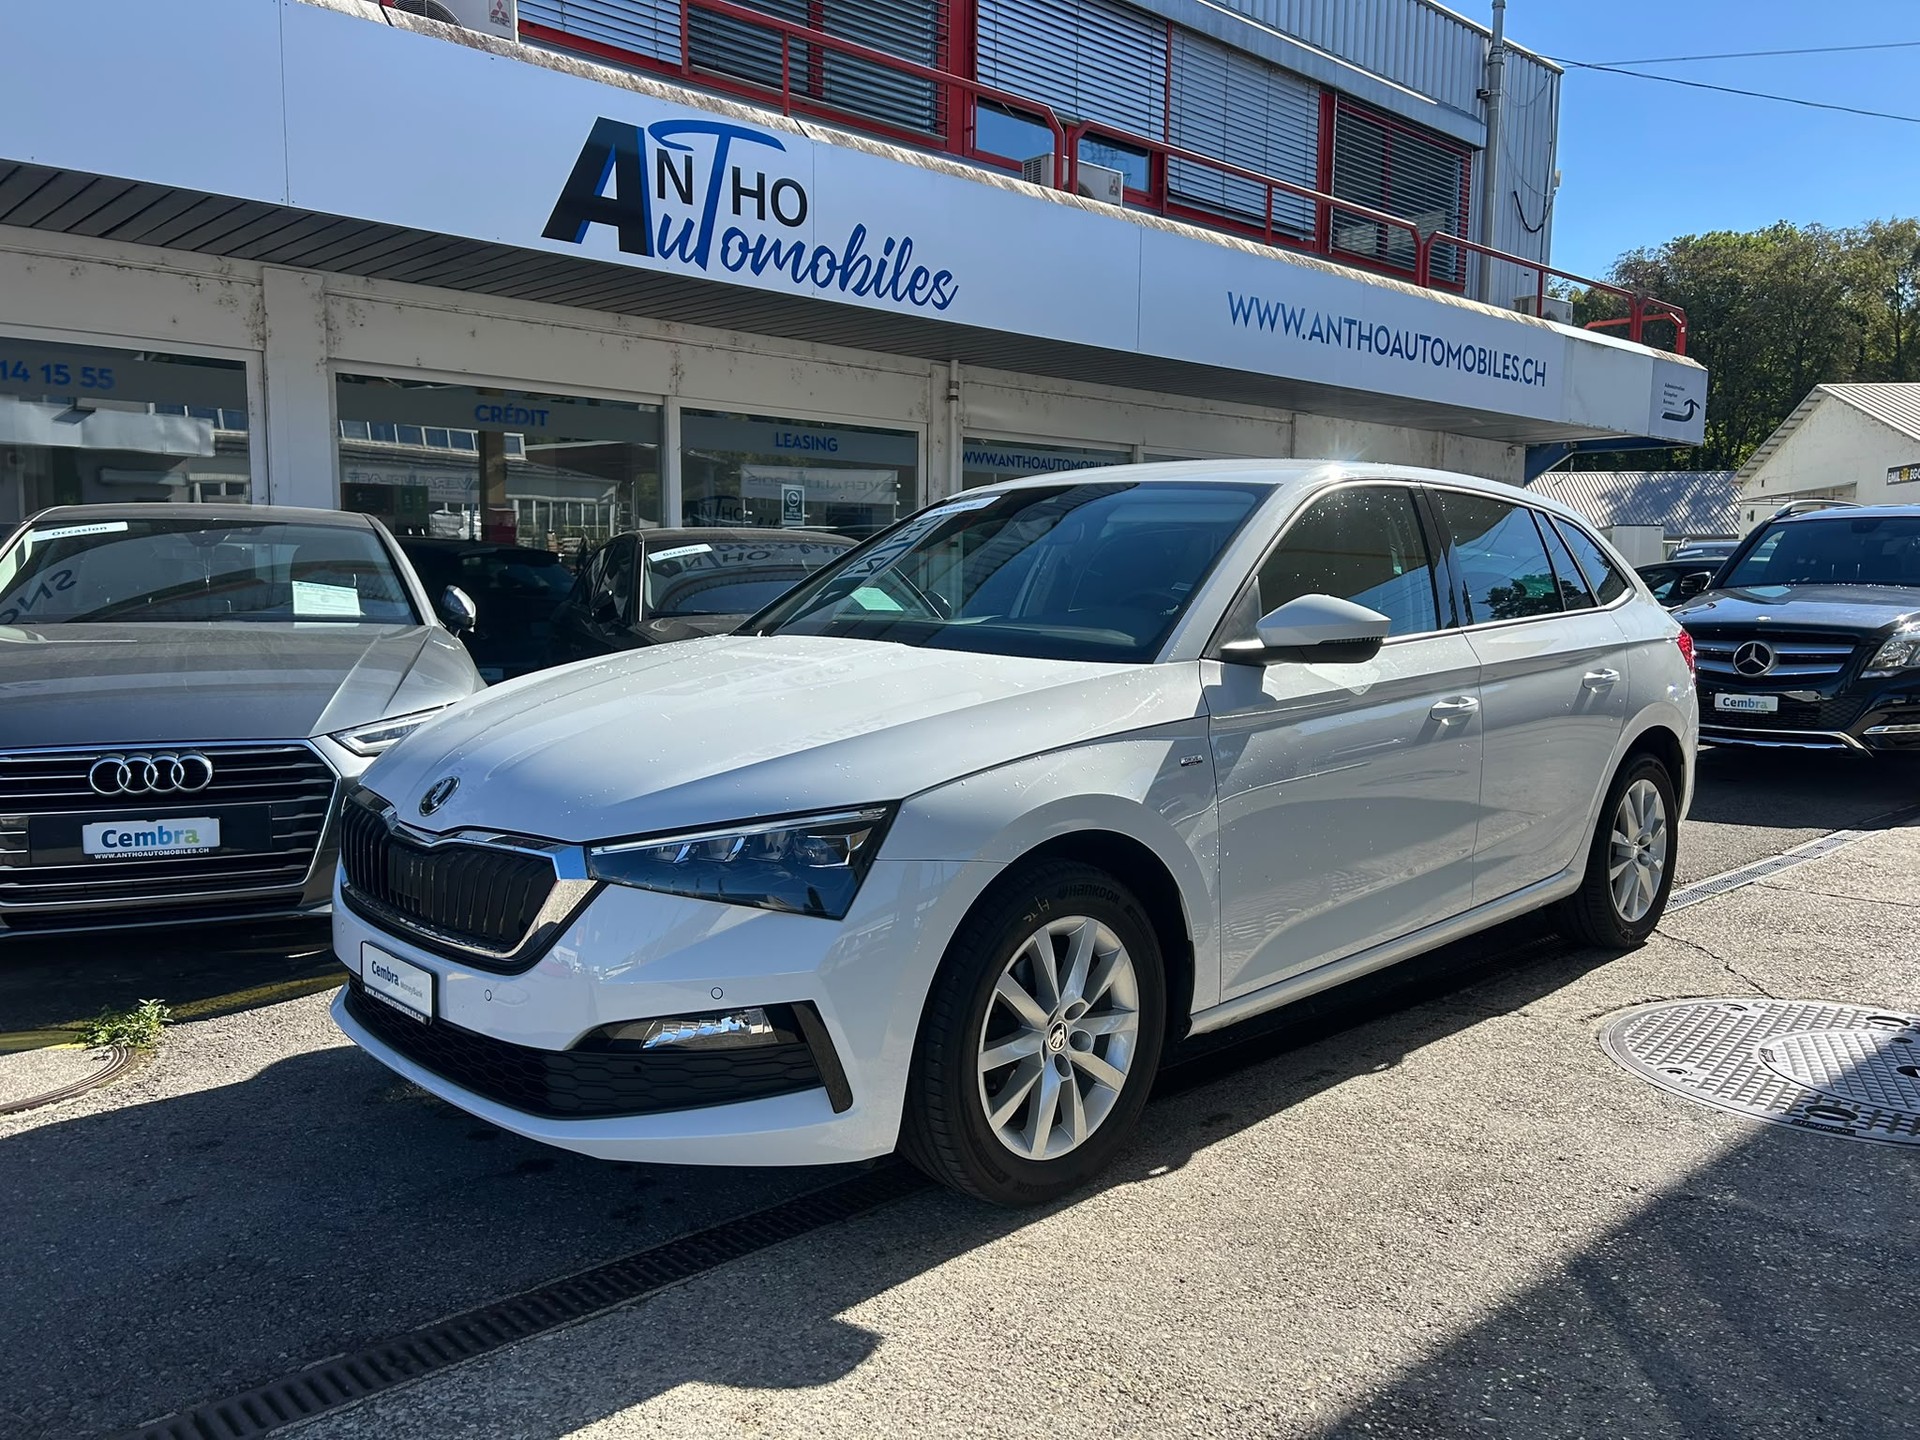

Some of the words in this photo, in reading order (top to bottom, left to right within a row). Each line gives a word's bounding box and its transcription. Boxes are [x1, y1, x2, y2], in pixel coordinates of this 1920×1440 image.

[1227, 291, 1547, 387] WWW.ANTHOAUTOMOBILES.CH
[40, 363, 72, 386] 15
[79, 366, 116, 390] 55
[475, 403, 549, 428] CRÉDIT
[775, 431, 839, 453] LEASING
[1722, 697, 1768, 710] Cembra
[101, 825, 200, 849] Cembra
[94, 847, 210, 860] WWW.ANTHOAUTOMOBILES.CH
[371, 960, 399, 987] Cembra
